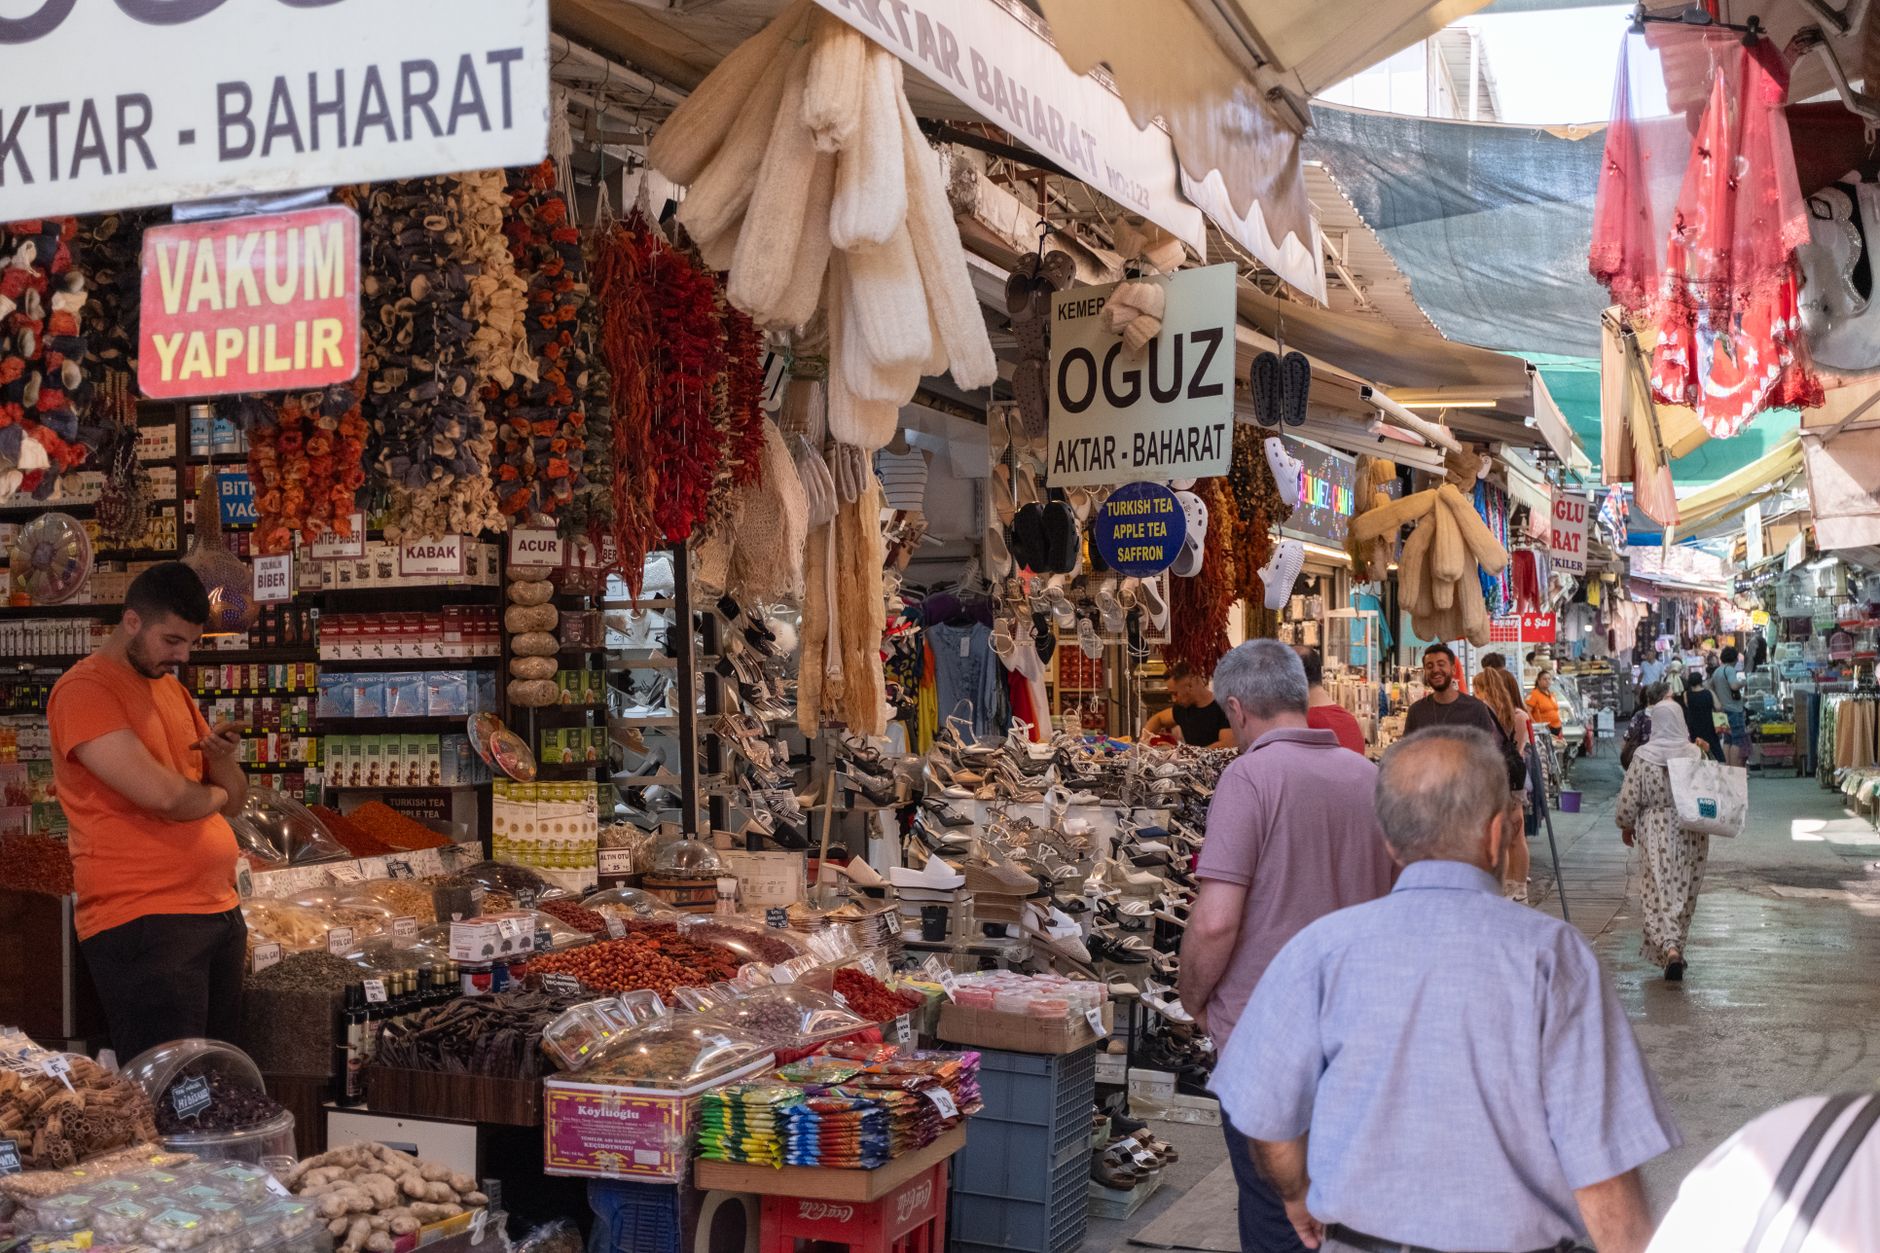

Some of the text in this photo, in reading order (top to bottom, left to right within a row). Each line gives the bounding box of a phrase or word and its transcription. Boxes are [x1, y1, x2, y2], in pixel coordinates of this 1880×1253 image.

[216, 47, 524, 162] BAHARAT
[969, 46, 1098, 178] BAHARAT
[155, 222, 345, 315] VAKUM
[152, 318, 344, 382] YAPILIR
[1053, 435, 1116, 474] AKTAR
[1133, 424, 1226, 468] BAHARAT
[1106, 498, 1174, 517] TURKISH TEA
[1552, 495, 1585, 523] ĞLU
[1113, 522, 1167, 539] APPLE TEA
[406, 546, 456, 559] KABAK
[518, 539, 557, 552] ACUR
[1117, 545, 1164, 562] SAFFRON
[1551, 557, 1583, 571] KİLER
[257, 570, 285, 589] BİBER
[389, 797, 445, 808] TURKISH TEA
[423, 810, 440, 819] TEA
